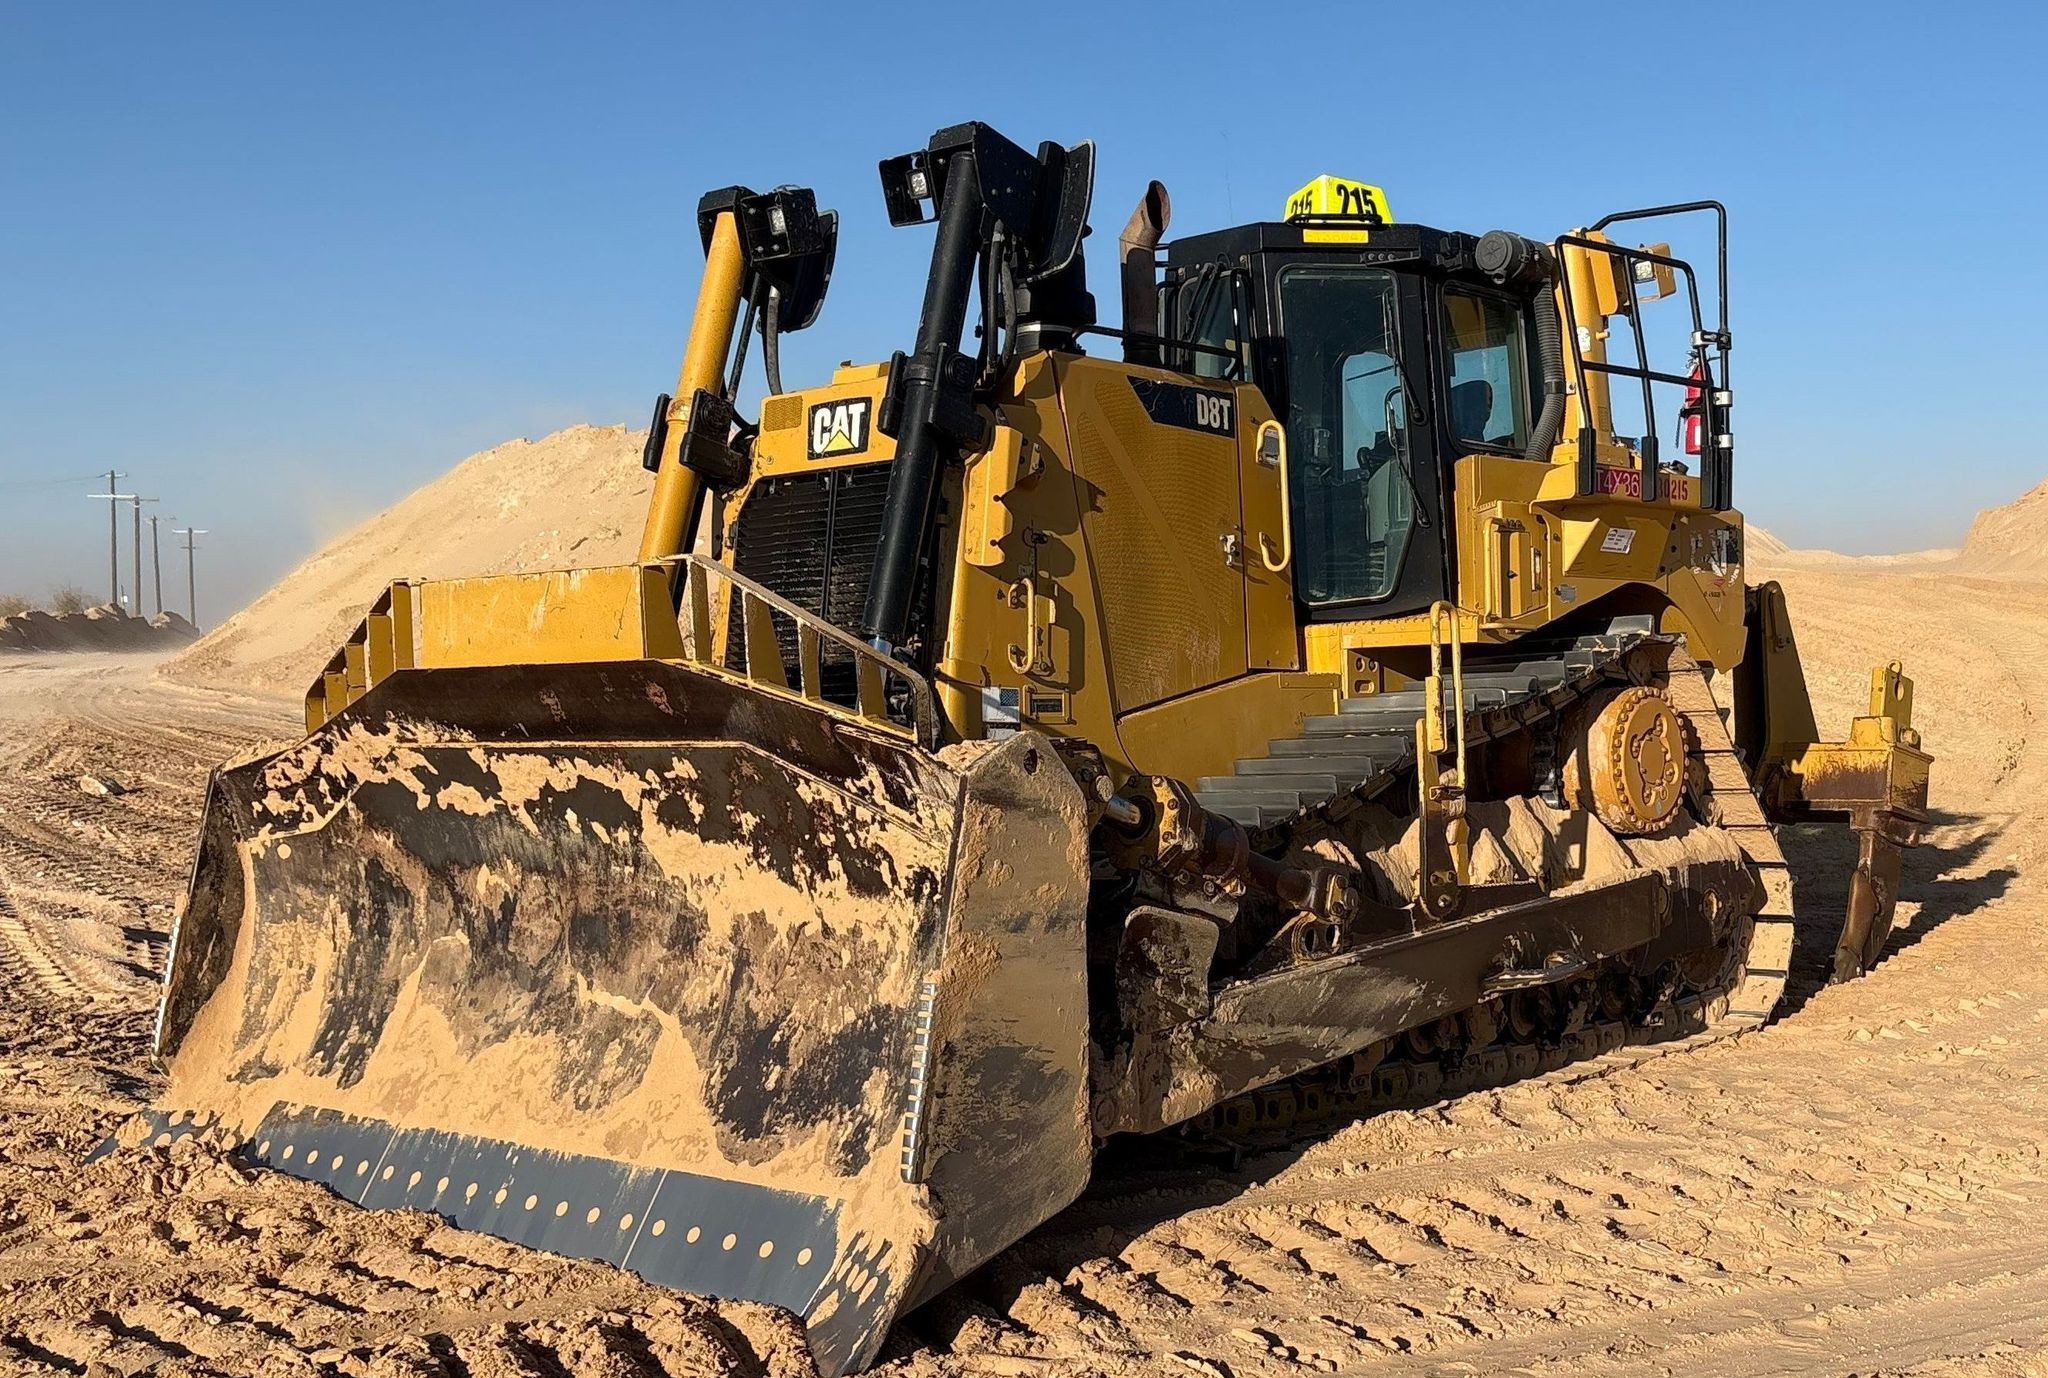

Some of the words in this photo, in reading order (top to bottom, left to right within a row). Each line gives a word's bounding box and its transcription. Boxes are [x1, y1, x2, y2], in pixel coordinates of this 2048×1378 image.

[1336, 183, 1377, 218] 215
[813, 402, 865, 454] CAT
[1196, 393, 1230, 430] D8T
